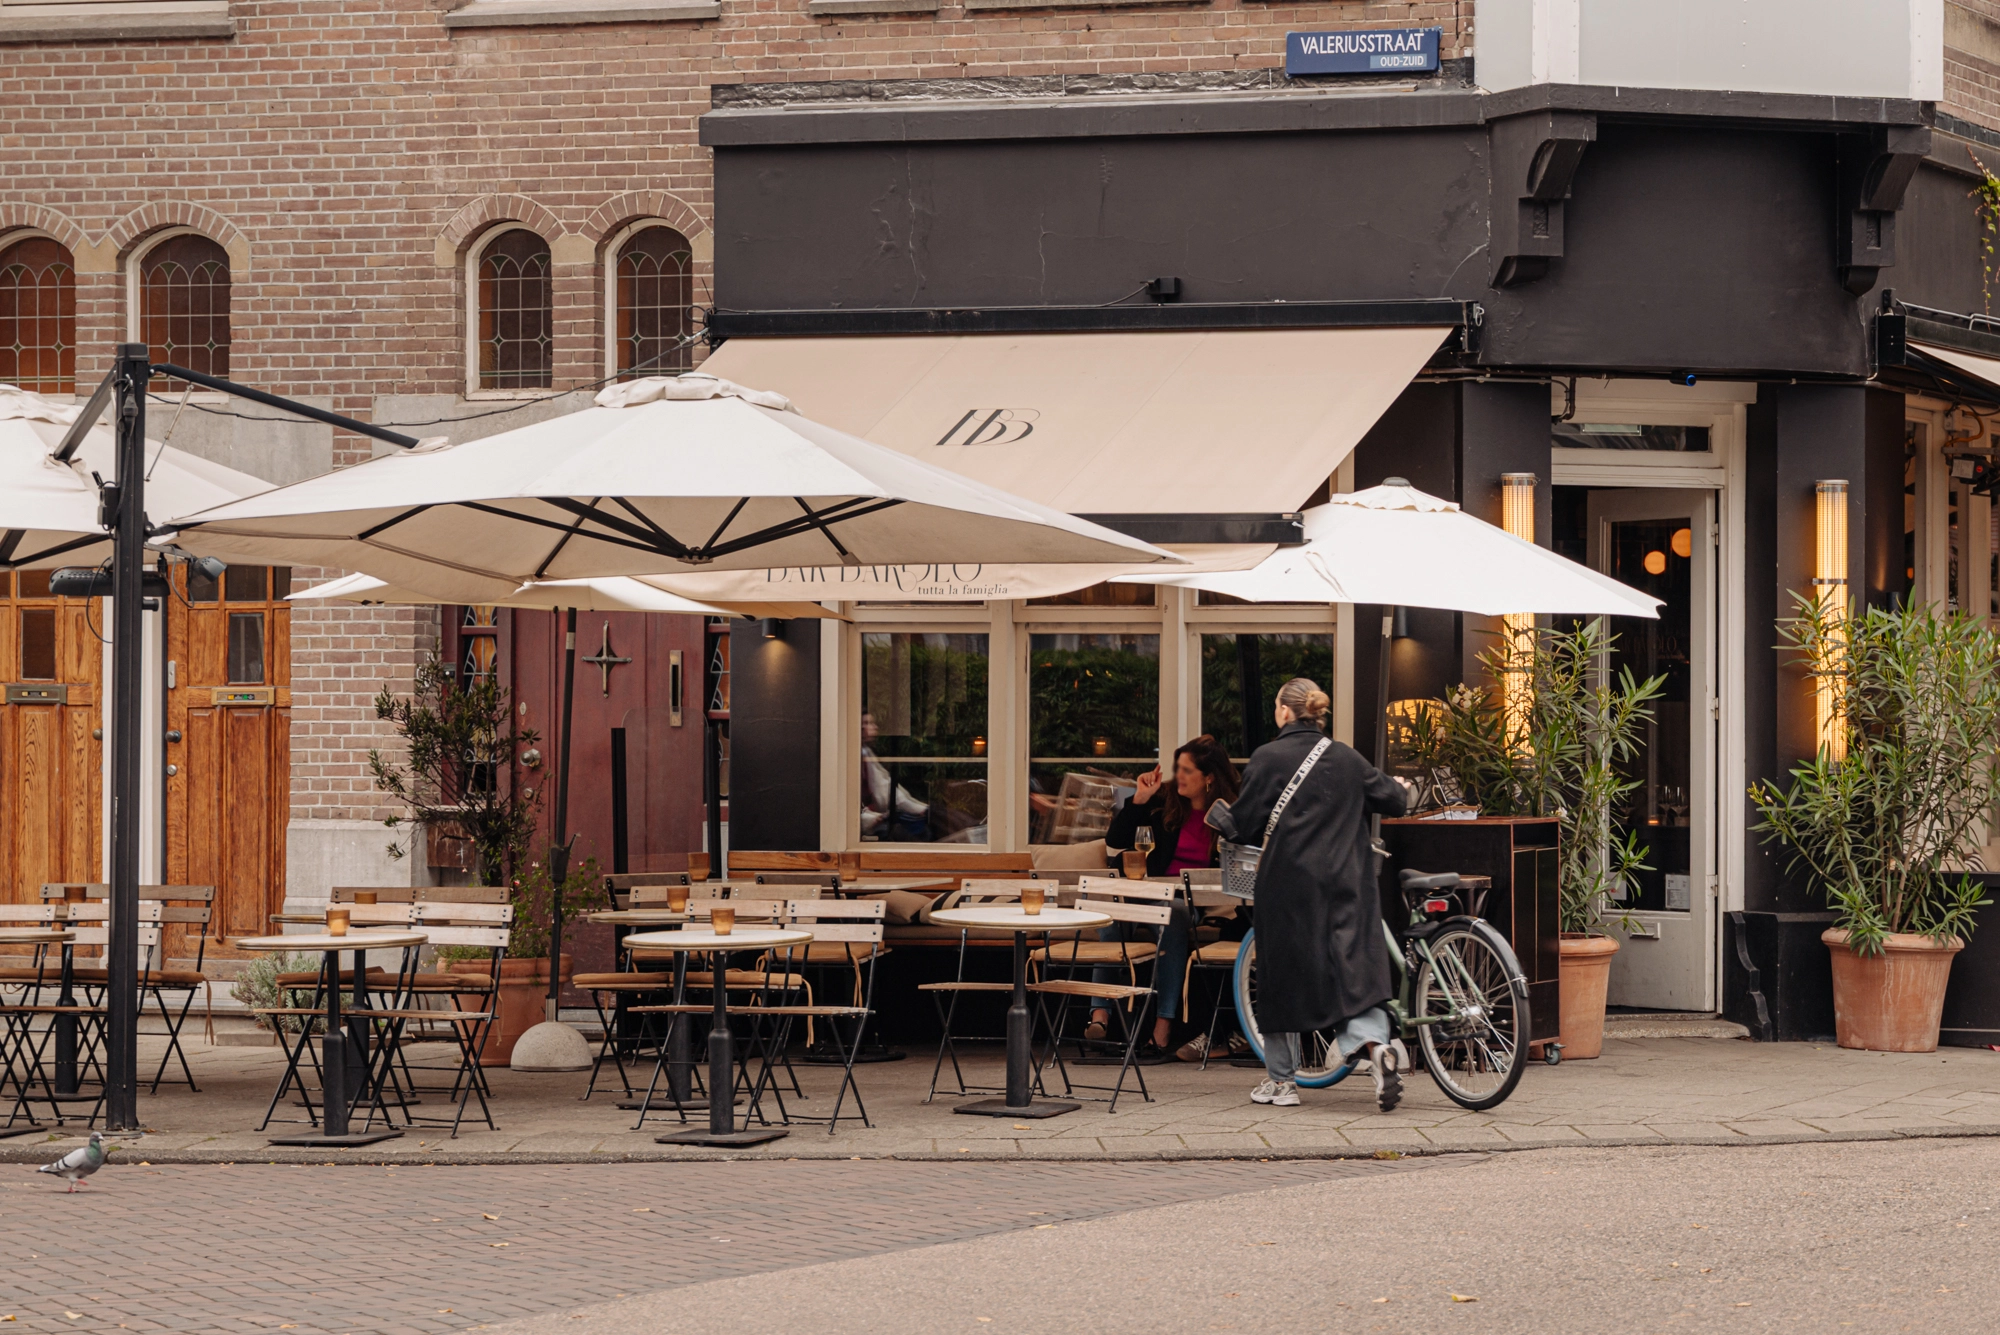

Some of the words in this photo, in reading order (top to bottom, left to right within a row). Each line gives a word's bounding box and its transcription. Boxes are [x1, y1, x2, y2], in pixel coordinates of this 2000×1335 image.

[1300, 33, 1424, 54] VALERIUSSTRAAT
[1380, 56, 1424, 67] OUD-ZUID
[918, 586, 944, 595] tutta
[949, 584, 958, 595] la
[963, 584, 1008, 597] famiglia
